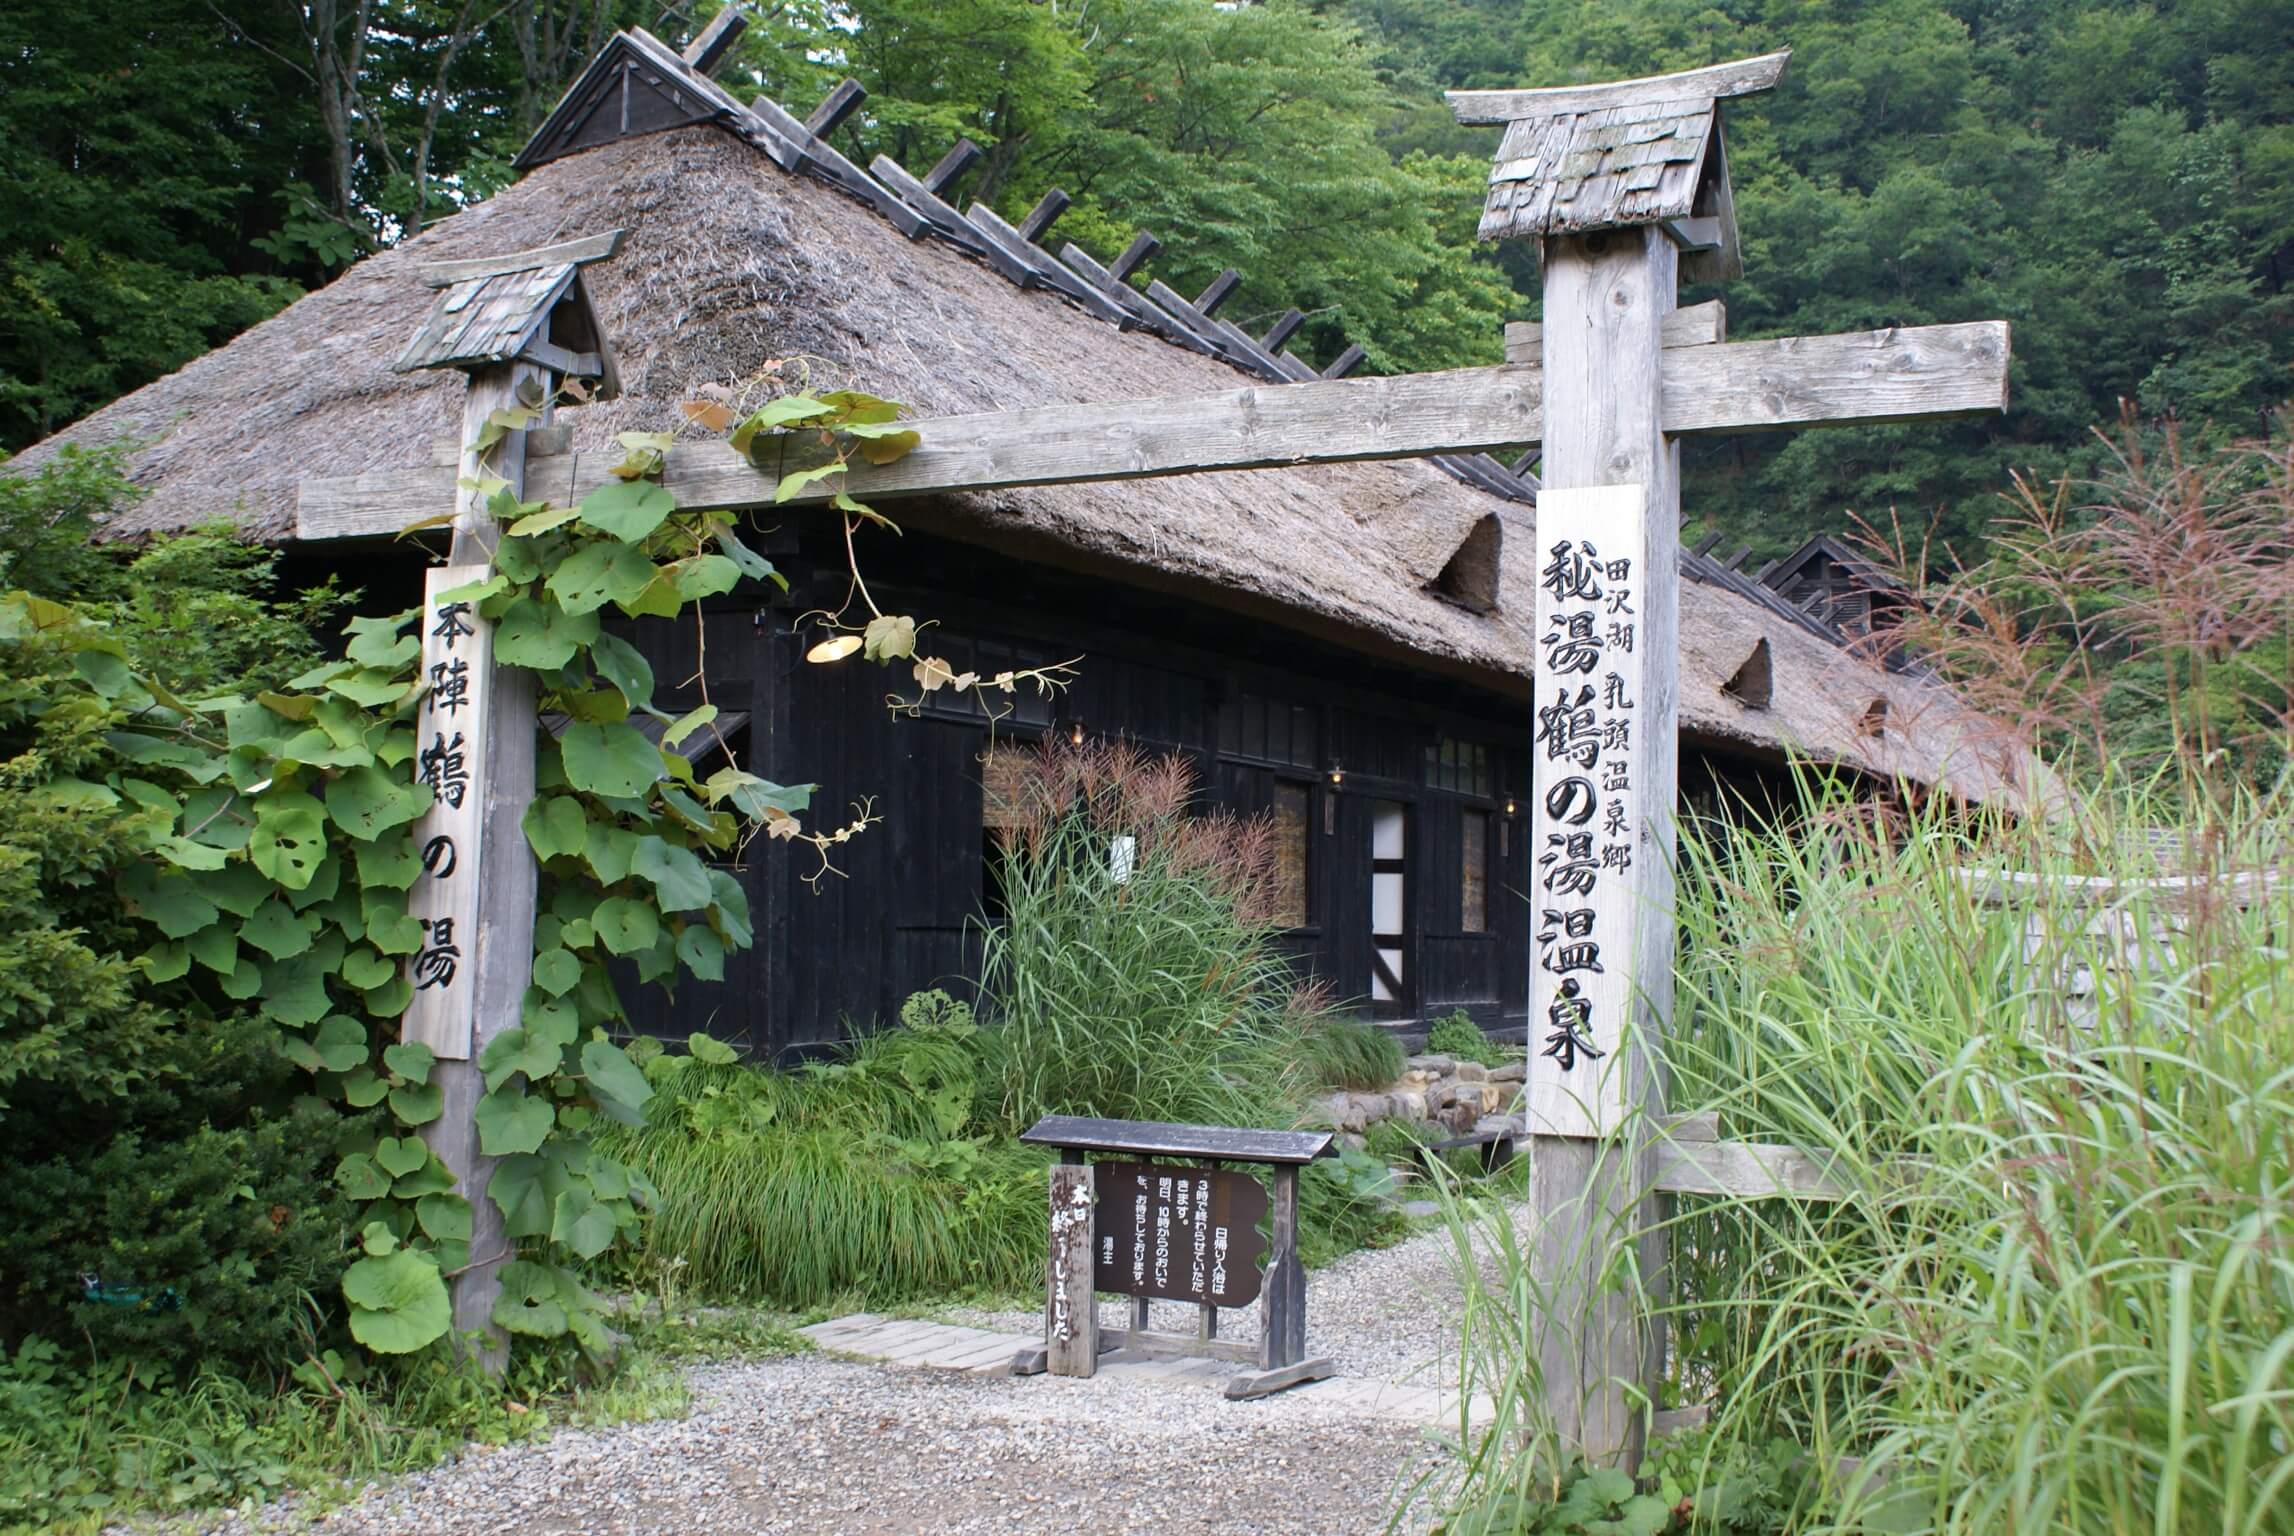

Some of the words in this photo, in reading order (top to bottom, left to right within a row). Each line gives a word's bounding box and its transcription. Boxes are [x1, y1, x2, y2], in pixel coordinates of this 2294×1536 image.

[415, 602, 476, 991] 本陣鶴の湯
[1536, 540, 1606, 1071] 秘湯鶴の湯温泉
[1176, 1180, 1189, 1226] きます。
[1212, 1227, 1228, 1294] 日帰り入浴は
